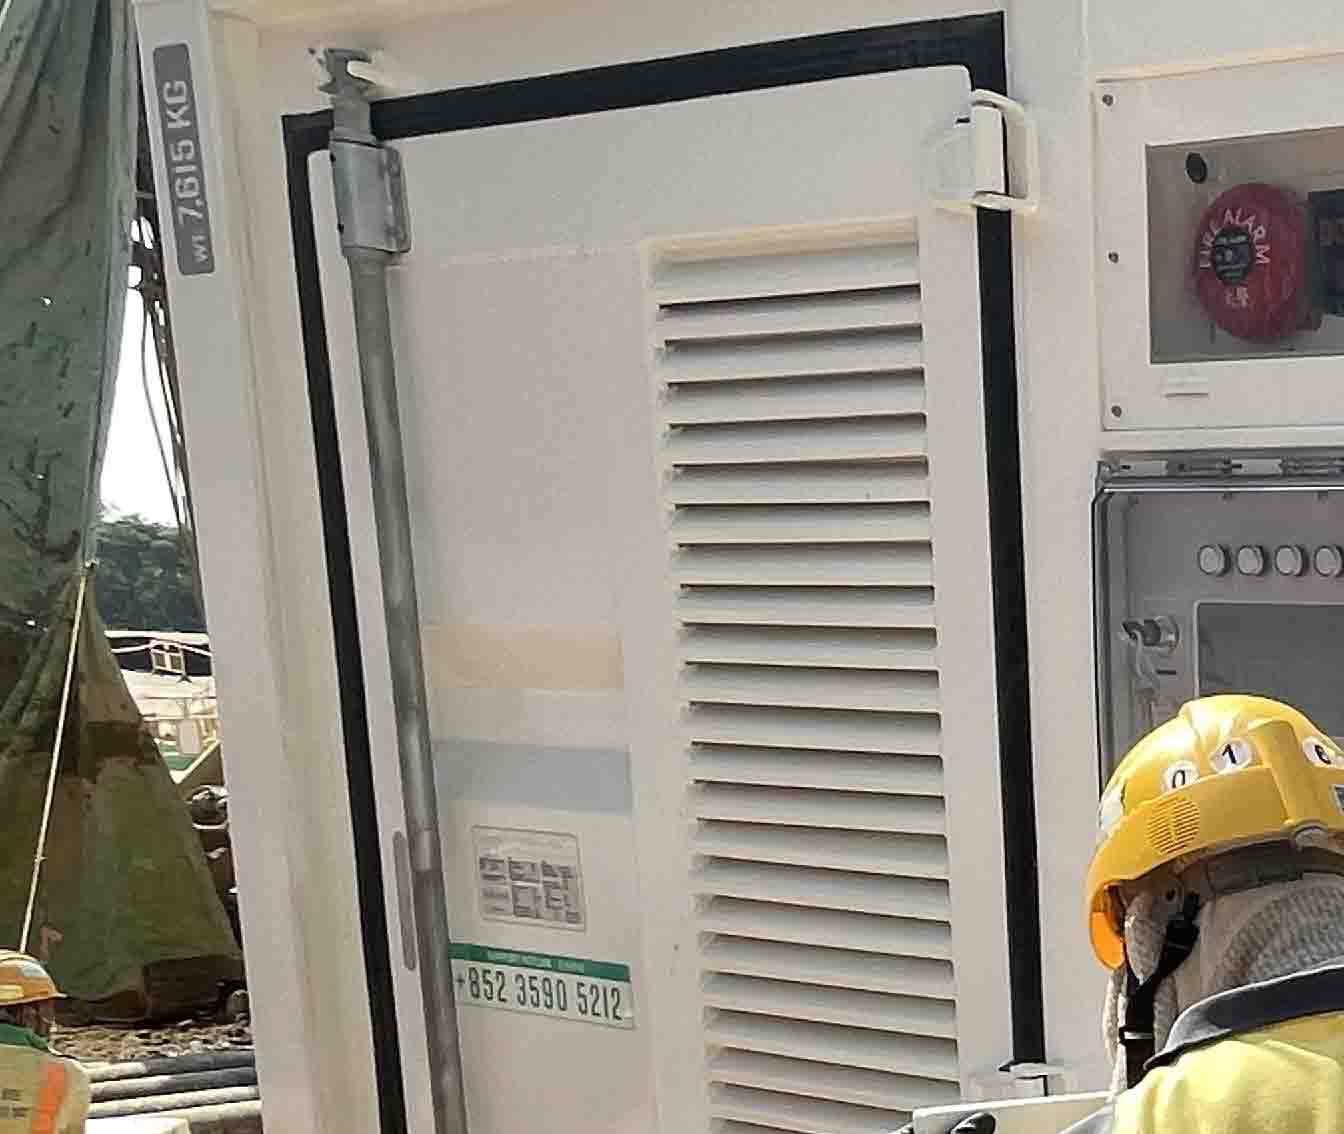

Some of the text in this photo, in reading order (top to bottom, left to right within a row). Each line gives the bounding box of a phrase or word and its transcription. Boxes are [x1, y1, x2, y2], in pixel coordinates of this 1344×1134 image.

[163, 80, 192, 129] KG
[1224, 207, 1272, 265] ALARM
[456, 966, 623, 1021] +852 3590 5212
